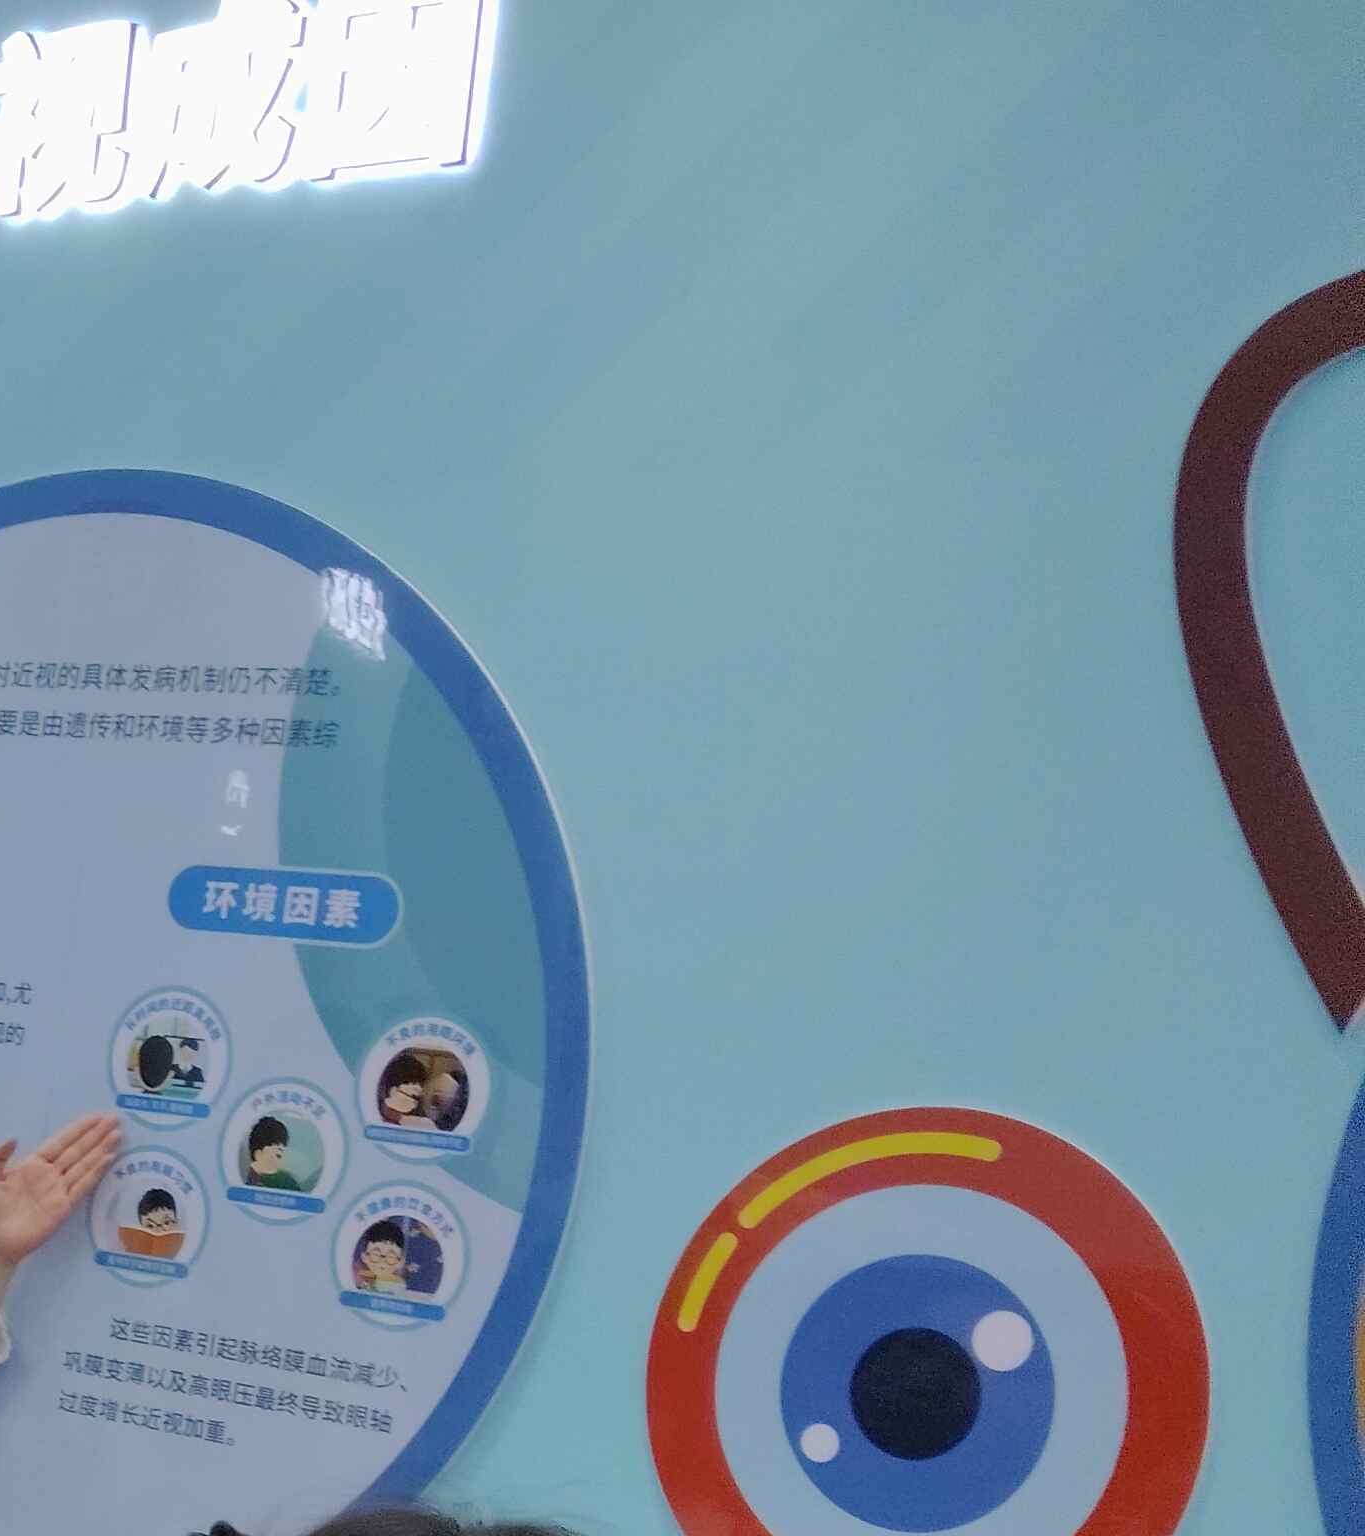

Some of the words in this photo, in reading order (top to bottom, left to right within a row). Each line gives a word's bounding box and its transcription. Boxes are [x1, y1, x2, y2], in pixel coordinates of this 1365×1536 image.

[203, 879, 362, 929] 环境因素
[58, 1389, 235, 1447] 过度增长近视加重。
